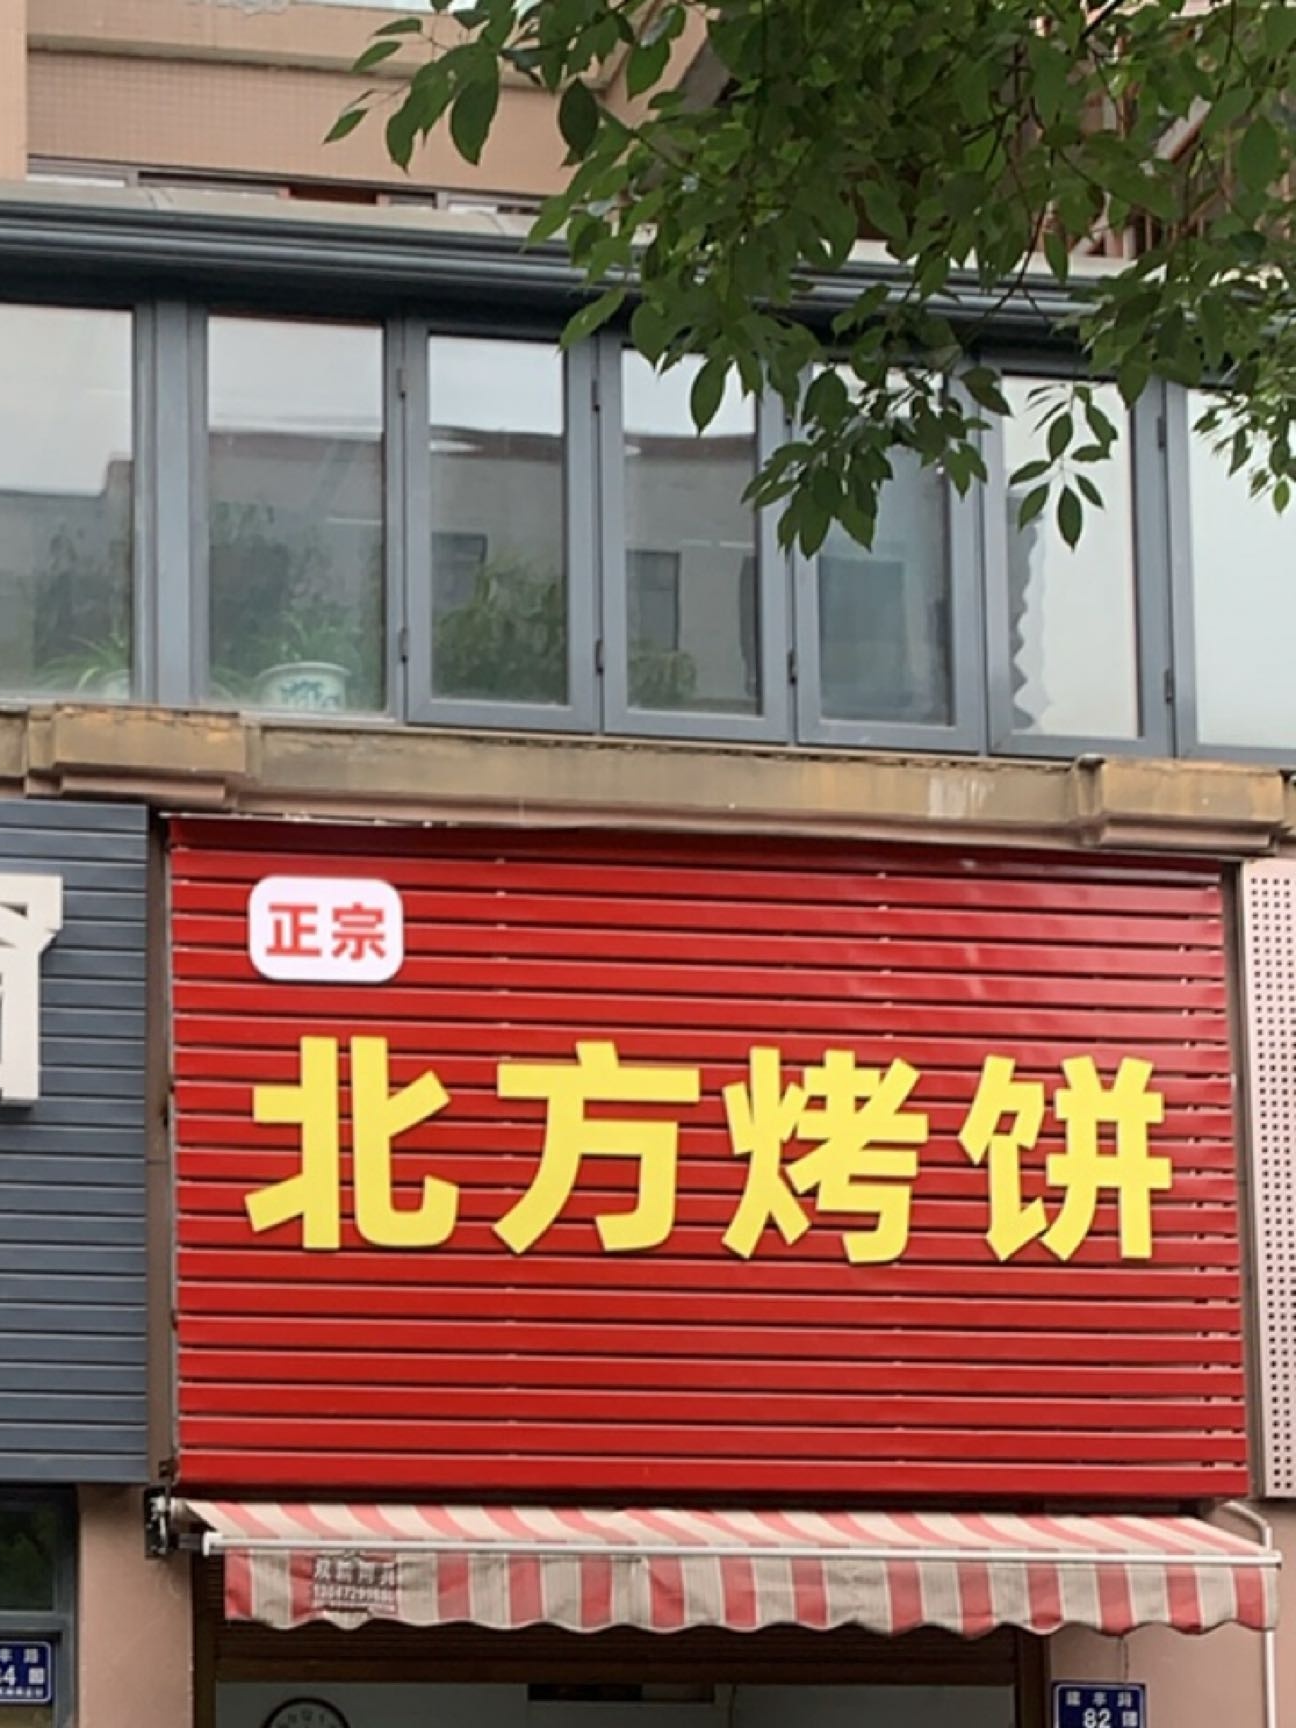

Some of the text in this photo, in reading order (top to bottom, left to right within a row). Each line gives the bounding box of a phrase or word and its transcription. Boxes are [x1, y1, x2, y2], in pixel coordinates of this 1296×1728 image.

[264, 902, 390, 963] 正宗
[243, 1035, 1174, 1264] 北方烤饼
[1083, 1707, 1111, 1728] 82
